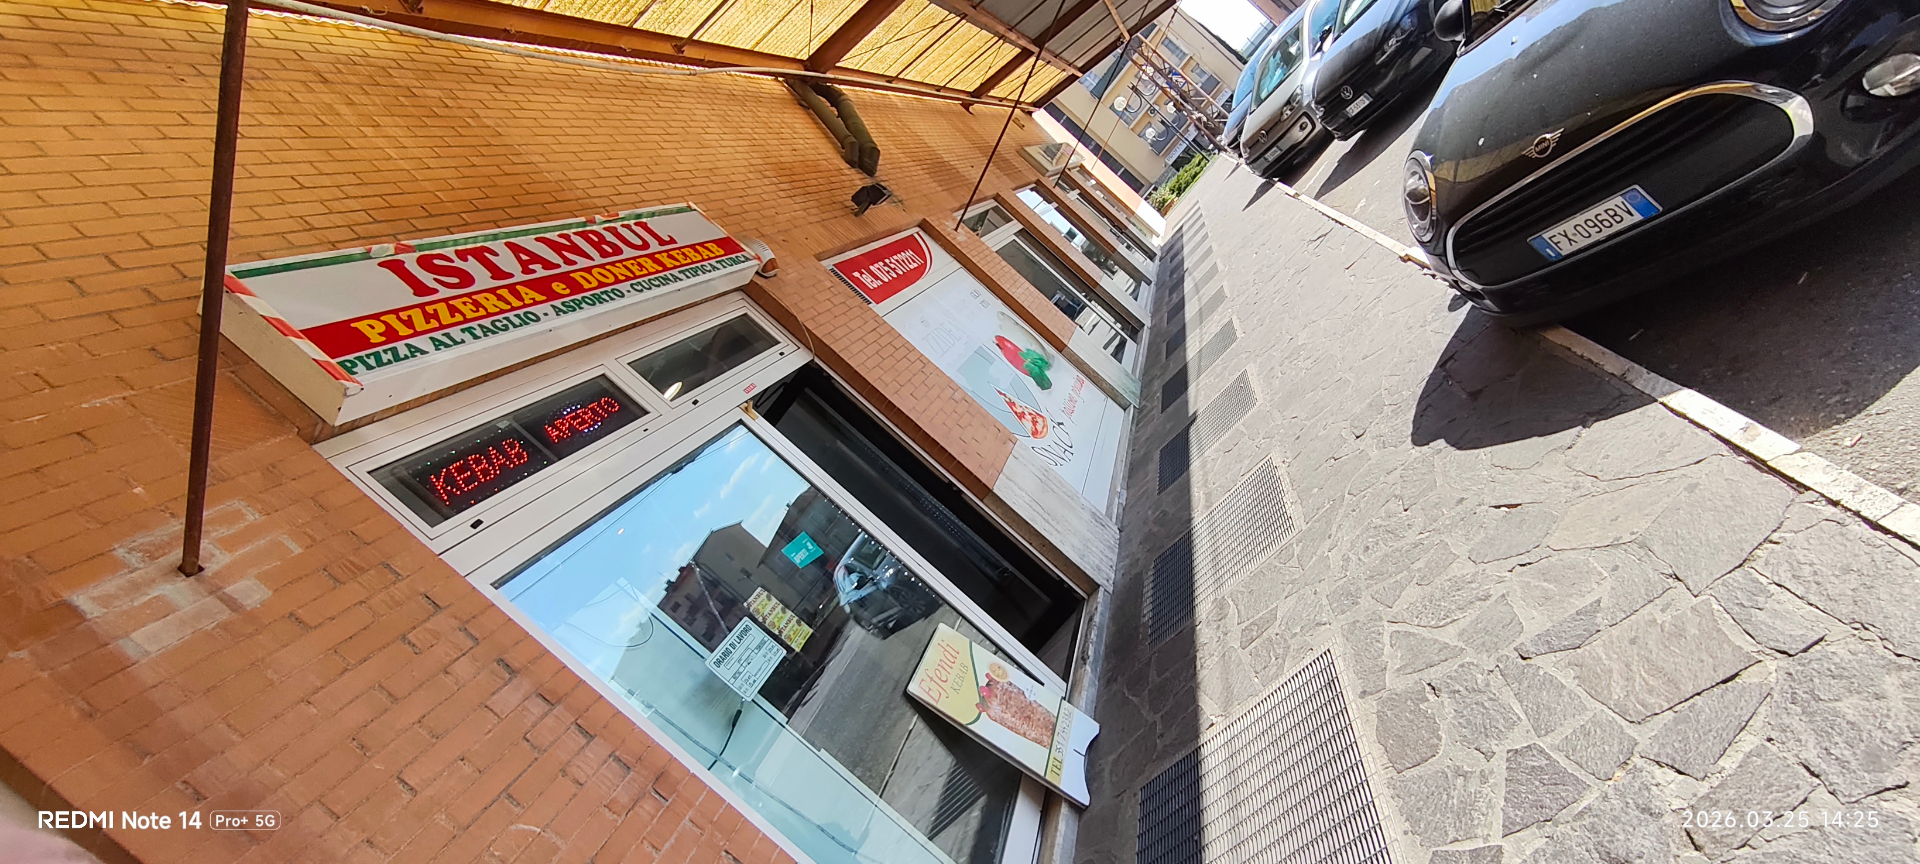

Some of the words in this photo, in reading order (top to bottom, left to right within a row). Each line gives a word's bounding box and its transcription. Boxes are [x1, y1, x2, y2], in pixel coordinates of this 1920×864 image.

[1535, 140, 1549, 152] MINI
[377, 221, 678, 297] ISTANBUL
[852, 269, 880, 289] Tel.
[868, 260, 896, 282] 075
[883, 248, 924, 274] 5172211
[336, 342, 429, 376] PIZZA
[428, 332, 466, 352] AL
[460, 310, 542, 341] TAGLIO
[549, 288, 626, 317] ASPORTO
[629, 272, 684, 294] CUCINA
[678, 262, 717, 279] TIPICA
[714, 253, 752, 269] TURCA
[350, 285, 547, 343] PIZZERIA
[551, 281, 570, 295] e
[570, 257, 659, 289] DONER
[655, 242, 725, 268] KEBAB
[430, 438, 529, 505] KEBAB
[544, 396, 621, 444] APERTO
[1031, 406, 1074, 467] SNACK
[713, 646, 732, 668] ORARIO
[733, 623, 752, 644] LAVORO
[919, 639, 960, 704] Efendi
[949, 662, 968, 694] KEBAB
[1049, 756, 1062, 776] TEL
